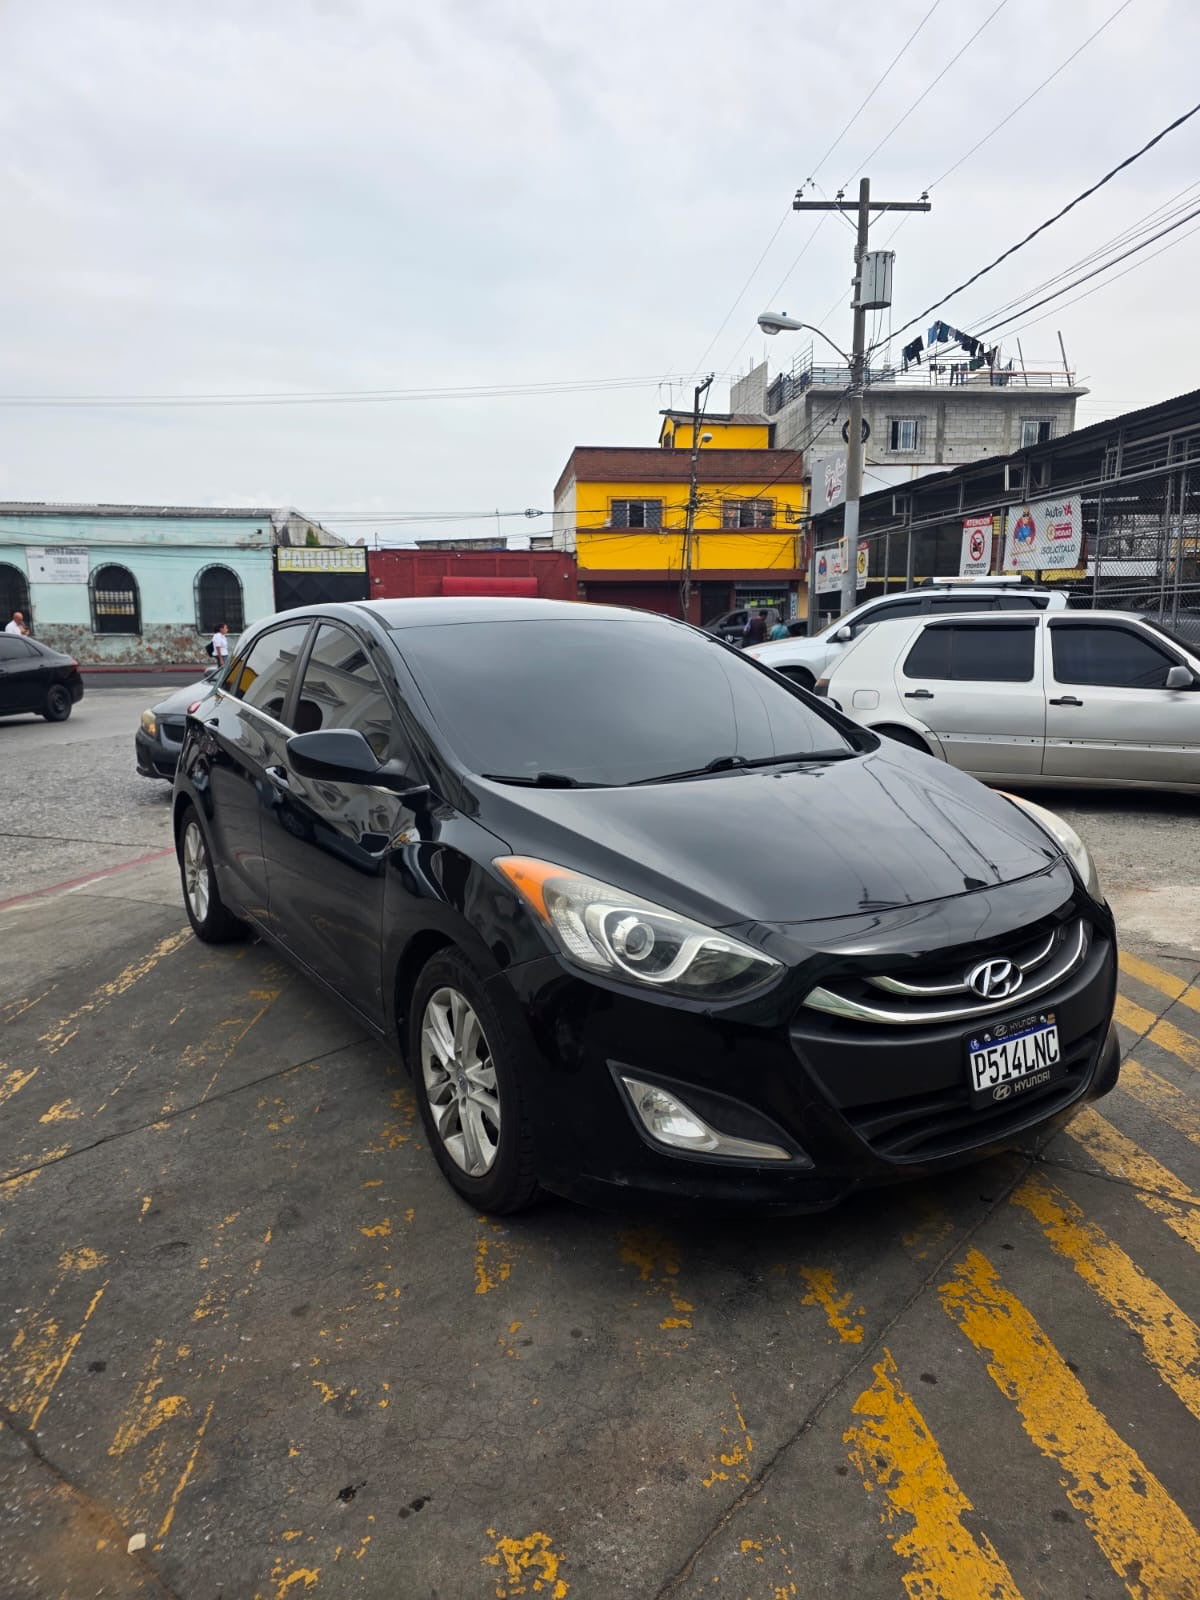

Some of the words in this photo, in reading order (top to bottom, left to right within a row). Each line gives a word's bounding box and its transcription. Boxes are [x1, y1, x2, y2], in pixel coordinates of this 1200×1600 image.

[1009, 1016, 1037, 1031] HYUNDAI
[974, 1029, 1058, 1088] P514LNC
[1014, 1070, 1051, 1093] HYUNDAI
